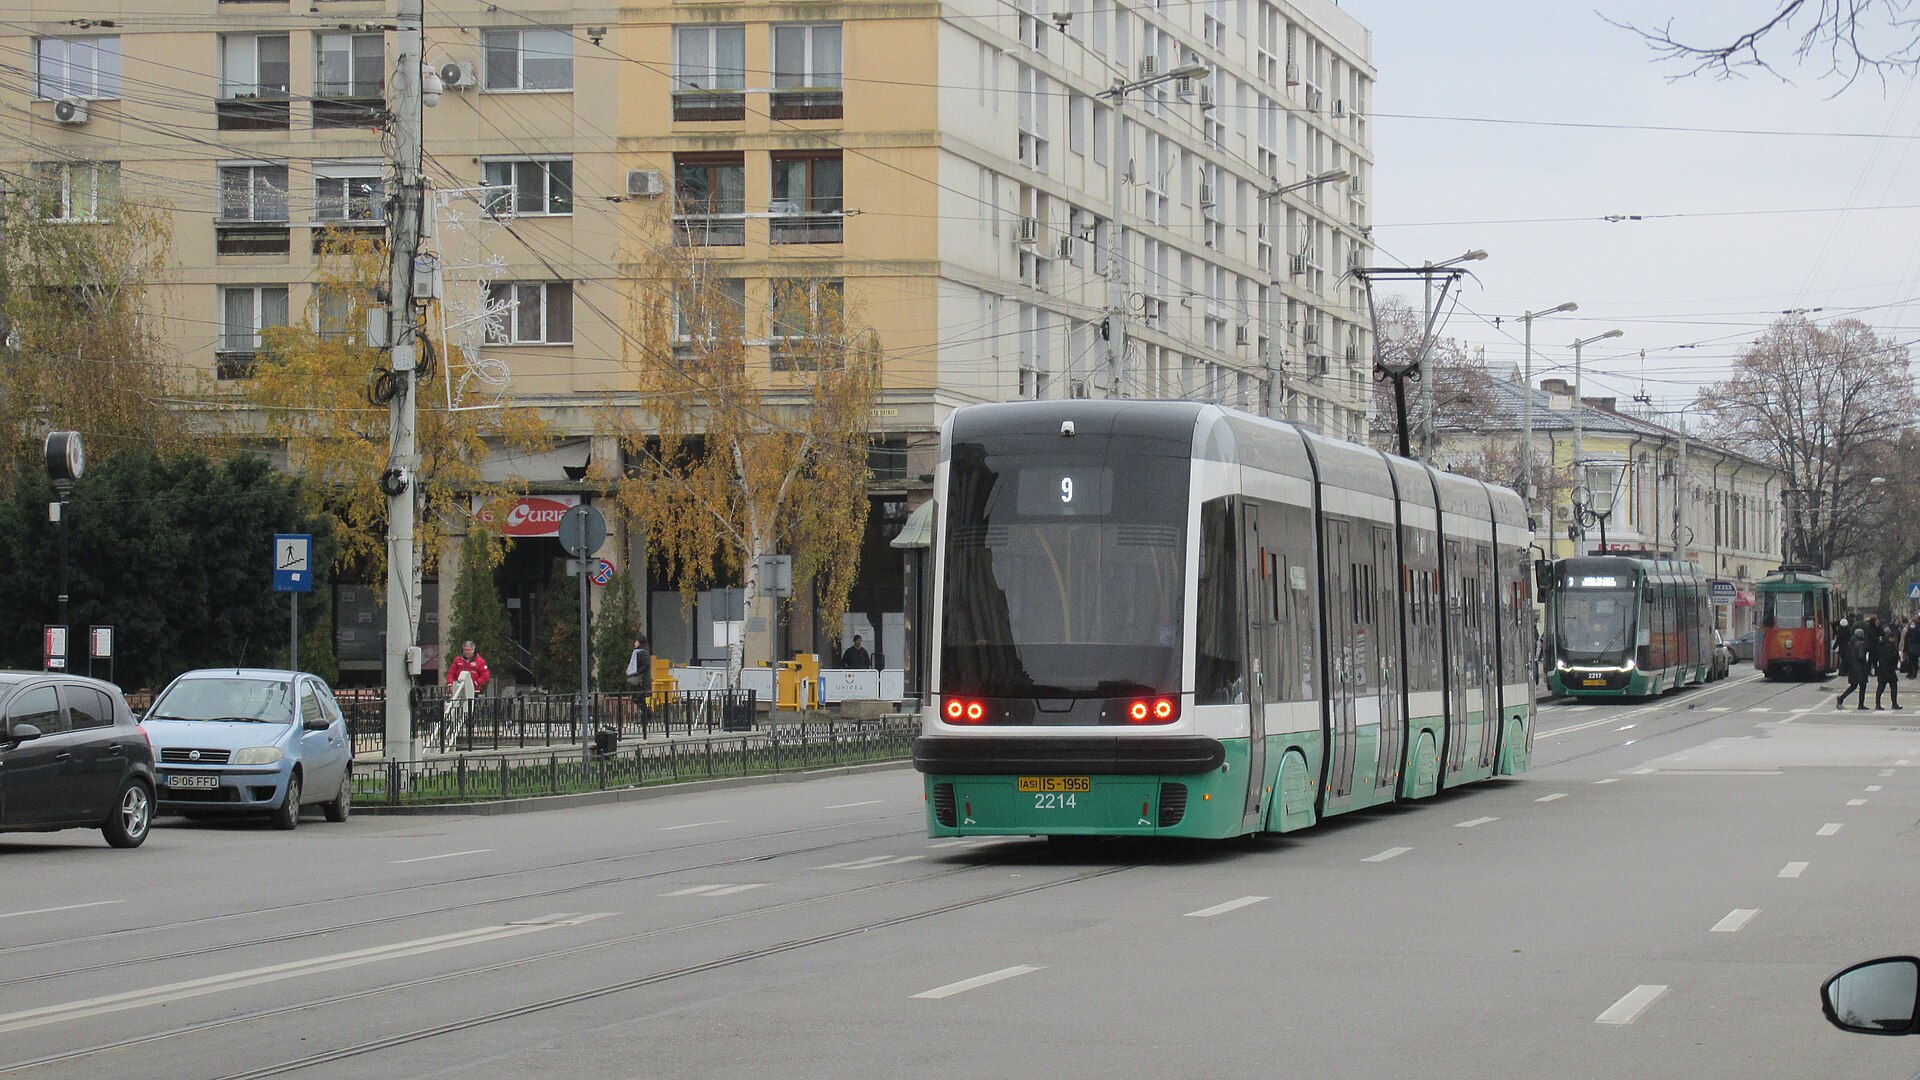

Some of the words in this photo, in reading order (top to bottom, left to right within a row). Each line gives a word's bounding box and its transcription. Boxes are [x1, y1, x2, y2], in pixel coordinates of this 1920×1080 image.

[1061, 477, 1073, 503] 9
[169, 776, 179, 786] IS
[182, 776, 194, 786] 06
[196, 777, 218, 787] FFD
[1034, 793, 1077, 809] 2214
